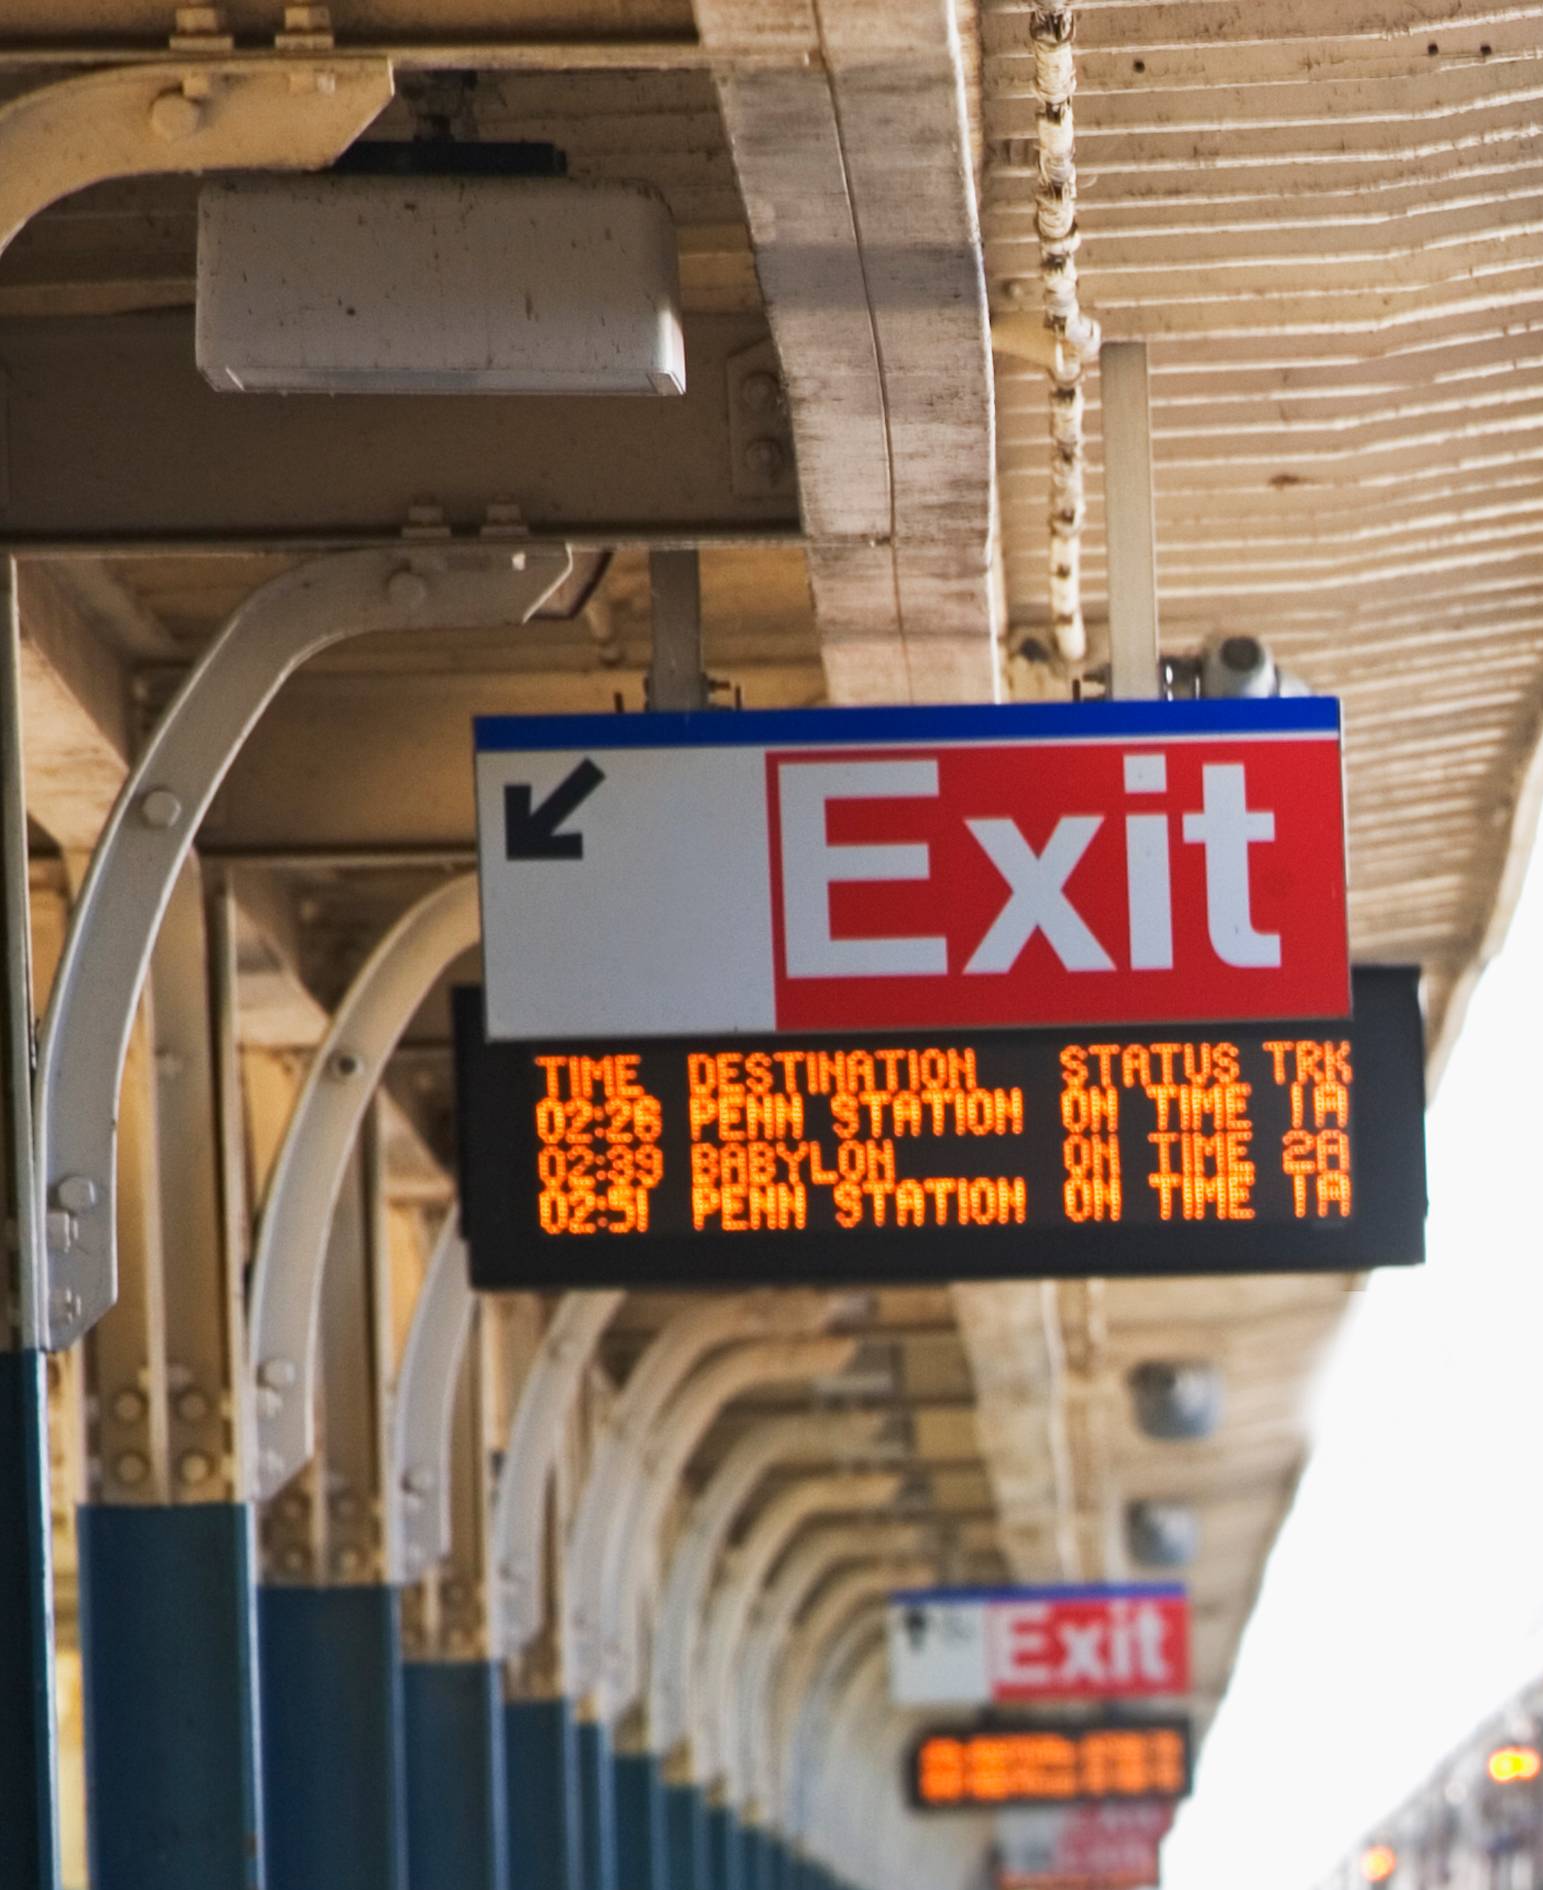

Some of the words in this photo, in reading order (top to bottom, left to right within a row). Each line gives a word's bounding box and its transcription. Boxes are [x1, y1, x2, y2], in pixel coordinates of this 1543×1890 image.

[777, 752, 1282, 979] Exit
[534, 1053, 645, 1098] TIME
[688, 1049, 976, 1095] DESTINATION
[1060, 1043, 1239, 1087] STATUS
[1262, 1040, 1352, 1085] TRK
[536, 1096, 663, 1144] 02:26
[689, 1093, 805, 1140] PENN
[830, 1087, 1023, 1138] STATION
[1061, 1085, 1119, 1134] ON
[1145, 1082, 1252, 1131] TIME
[1290, 1081, 1350, 1129] 1A
[537, 1143, 665, 1189] 02:39
[691, 1139, 895, 1186] BABYLON
[1063, 1132, 1121, 1177] ON
[1147, 1131, 1253, 1176] TIME
[1281, 1129, 1350, 1174] 2A
[539, 1187, 649, 1235] 02:51
[692, 1183, 807, 1231] PENN
[833, 1178, 1026, 1228] STATION
[1064, 1175, 1121, 1223] ON
[1148, 1172, 1256, 1220] TIME
[990, 1599, 1168, 1684] Exit
